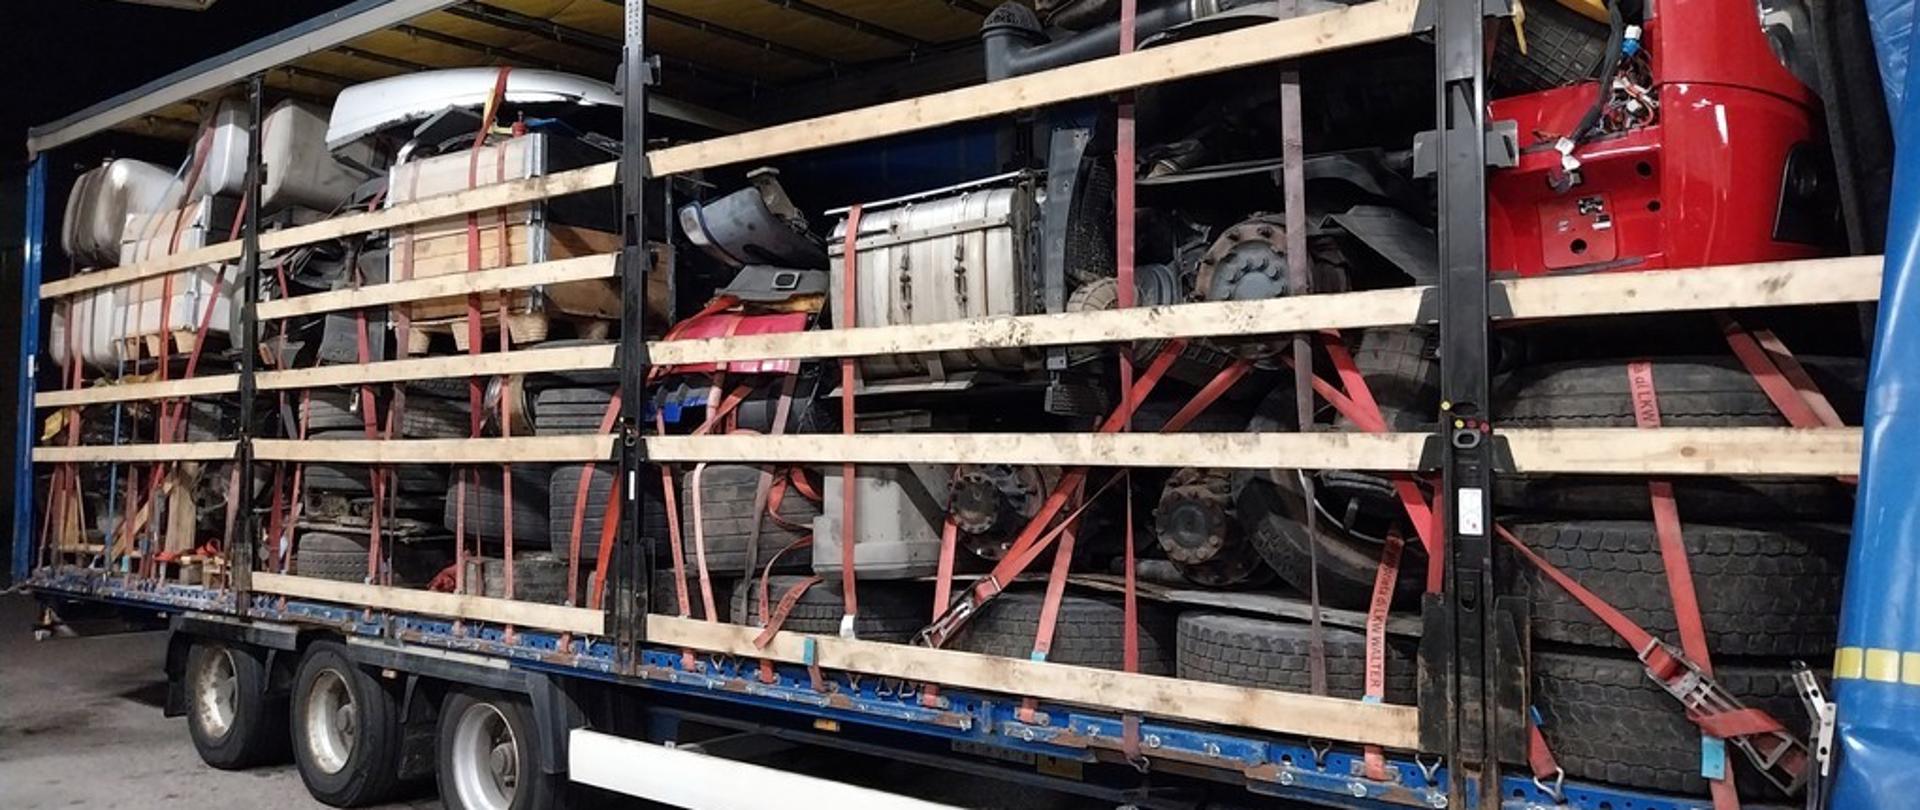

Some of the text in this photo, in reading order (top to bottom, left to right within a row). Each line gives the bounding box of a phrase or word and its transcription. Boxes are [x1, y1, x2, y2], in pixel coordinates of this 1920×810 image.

[1637, 392, 1656, 421] LKW
[1372, 607, 1386, 633] LKW
[1370, 636, 1382, 687] WALTER
